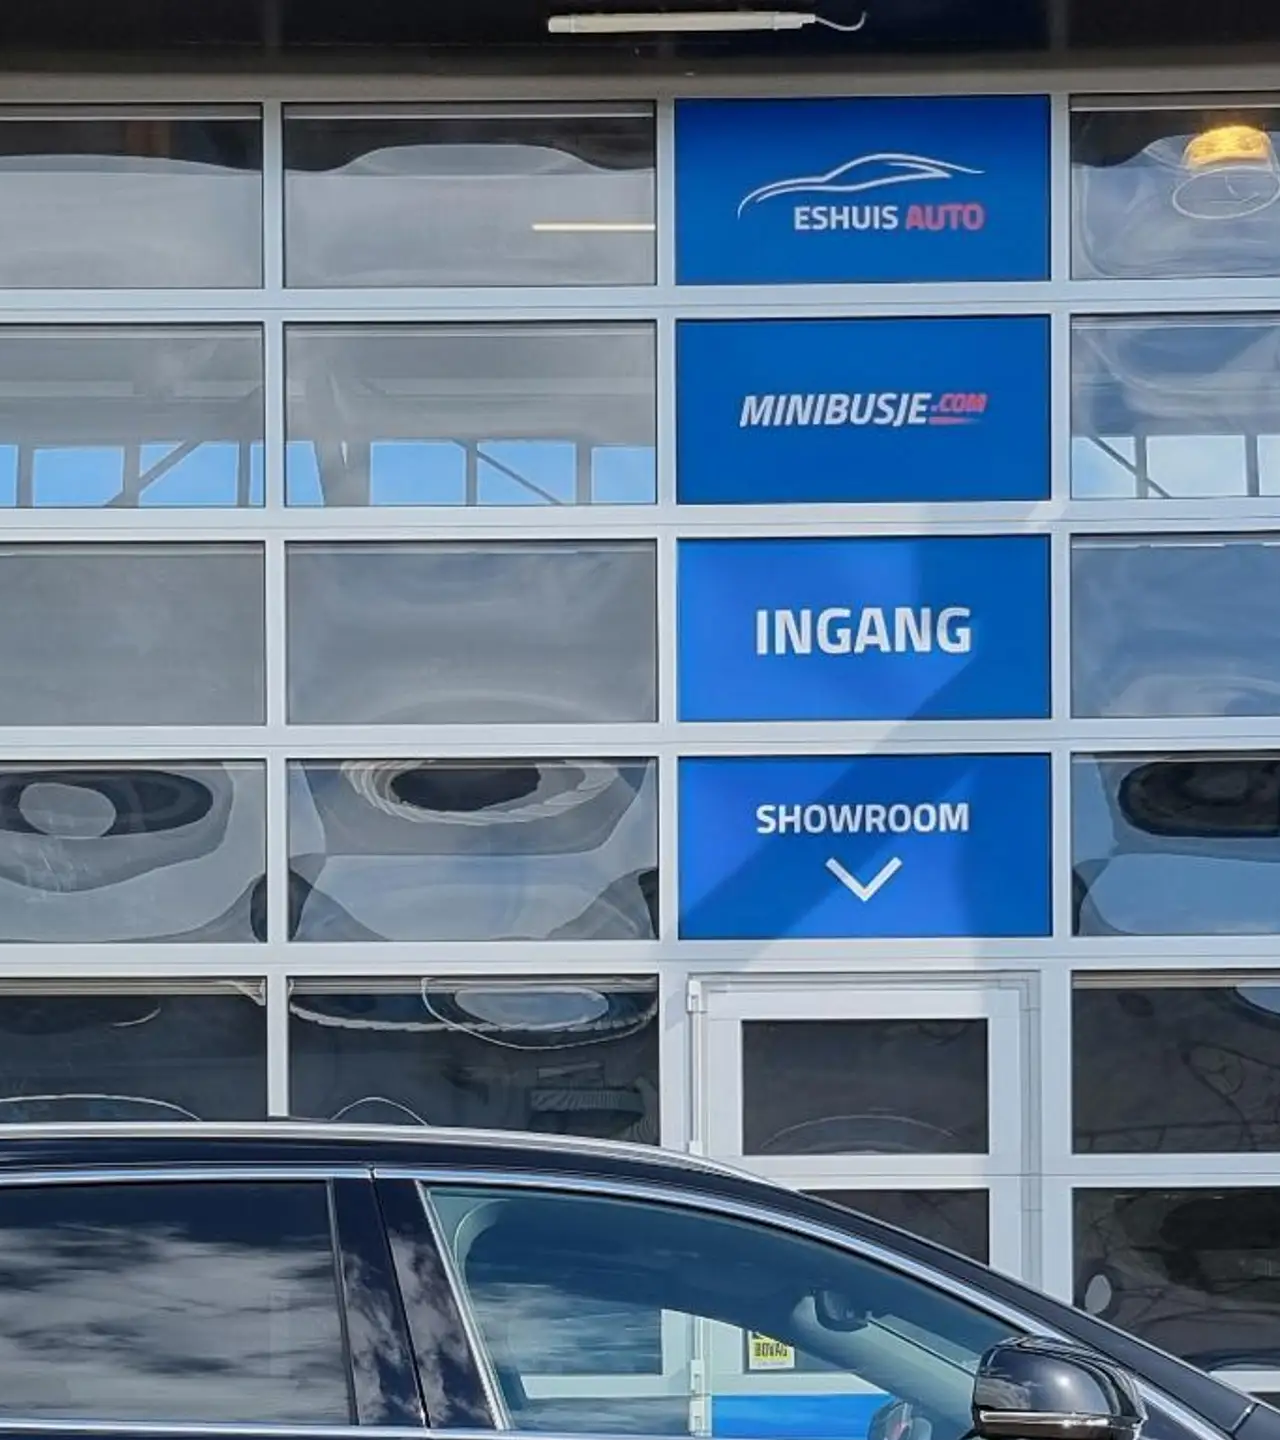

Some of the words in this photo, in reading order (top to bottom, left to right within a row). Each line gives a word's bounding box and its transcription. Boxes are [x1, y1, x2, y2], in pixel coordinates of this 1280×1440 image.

[793, 205, 899, 231] ESHUIS
[905, 203, 985, 231] AUTO
[756, 607, 971, 655] INGANG
[756, 802, 970, 834] SHOWROOM
